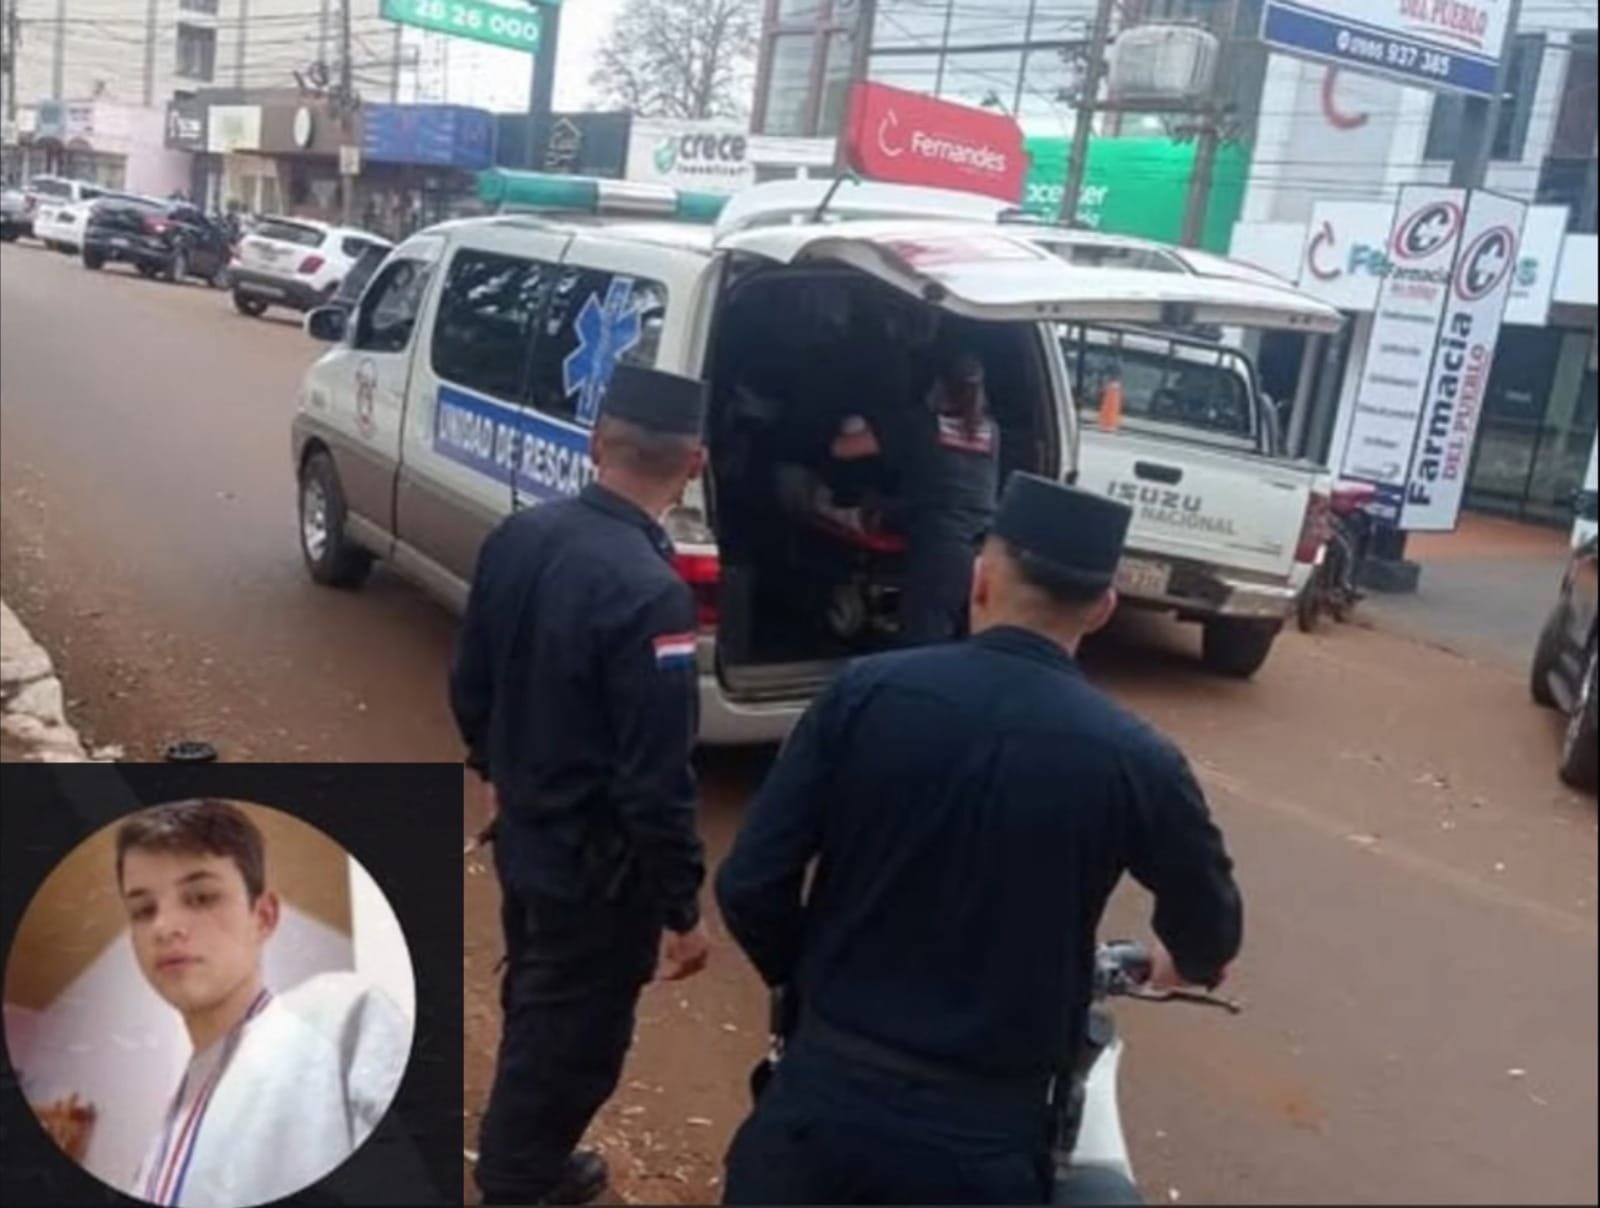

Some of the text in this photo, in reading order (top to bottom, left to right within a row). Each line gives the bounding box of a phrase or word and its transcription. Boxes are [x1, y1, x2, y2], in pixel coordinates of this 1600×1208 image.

[489, 13, 538, 41] 000
[680, 133, 747, 161] crece
[911, 131, 1006, 173] Fernandes
[1407, 311, 1473, 505] Farmacia
[1442, 343, 1487, 480] DEL PUEBLO
[439, 401, 600, 497] UNIDAD DE RESCAT
[1107, 480, 1202, 510] ISUZU
[1141, 509, 1236, 535] NACIONAL
